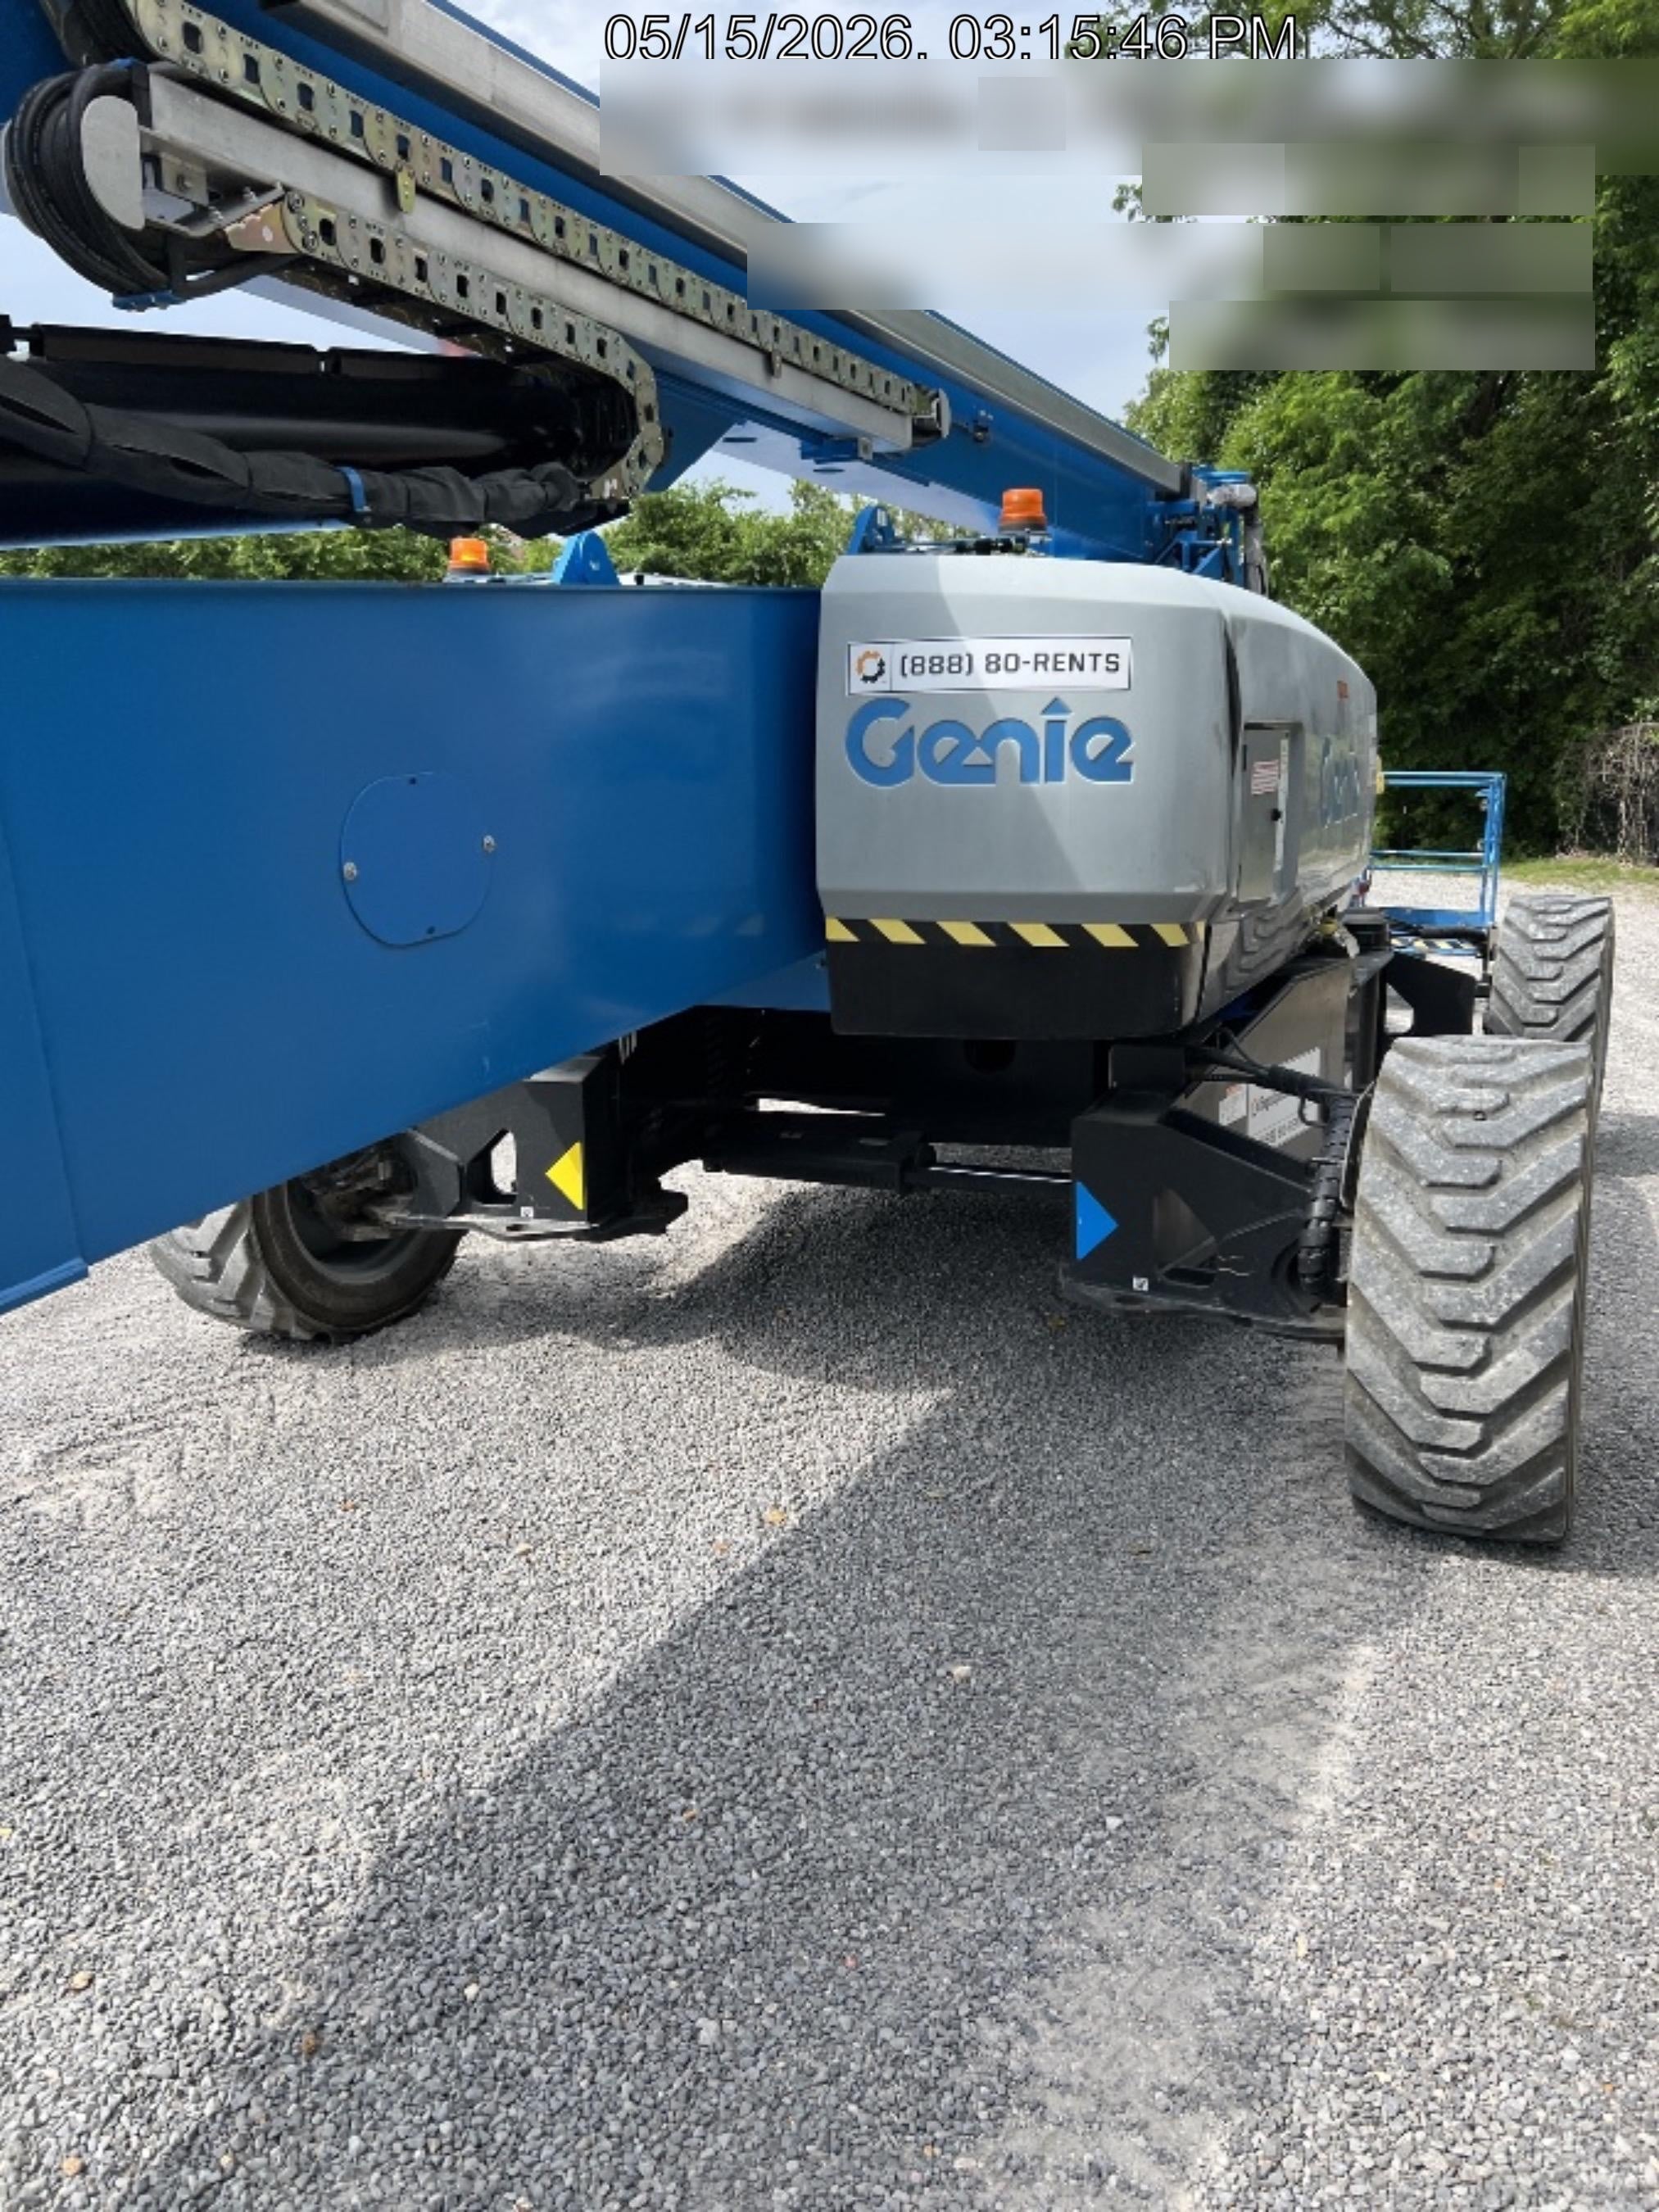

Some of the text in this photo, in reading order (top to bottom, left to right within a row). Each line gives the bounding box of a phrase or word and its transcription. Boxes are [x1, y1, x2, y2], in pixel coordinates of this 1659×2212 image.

[900, 652, 1121, 677] (888) 80-RENTS
[845, 696, 1135, 788] Genie
